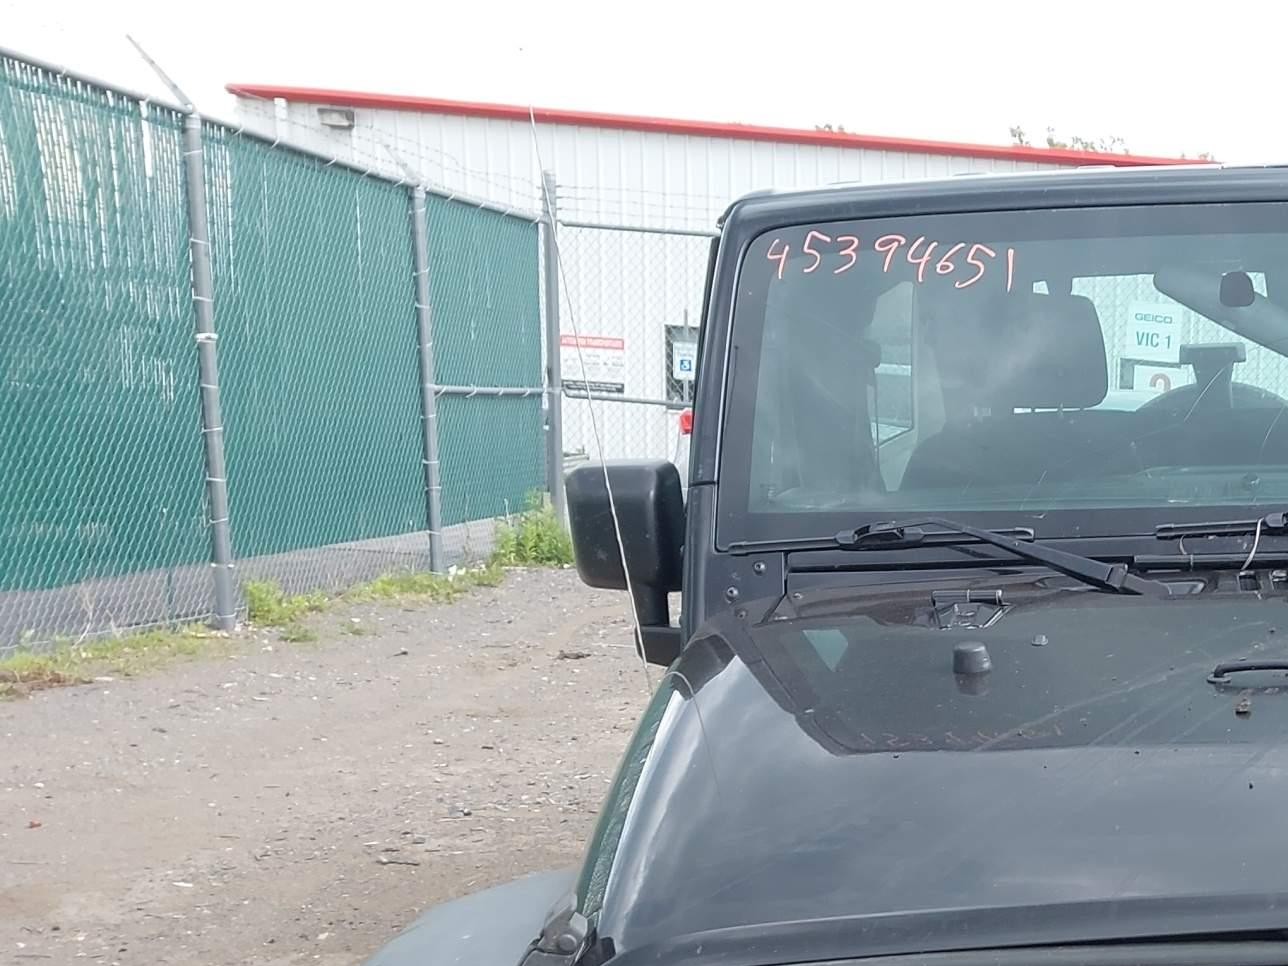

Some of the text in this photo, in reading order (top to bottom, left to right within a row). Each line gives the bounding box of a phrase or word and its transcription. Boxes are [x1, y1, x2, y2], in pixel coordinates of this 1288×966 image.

[766, 230, 1015, 293] 45394651
[1134, 312, 1173, 325] GEICO
[1136, 331, 1160, 348] VIC
